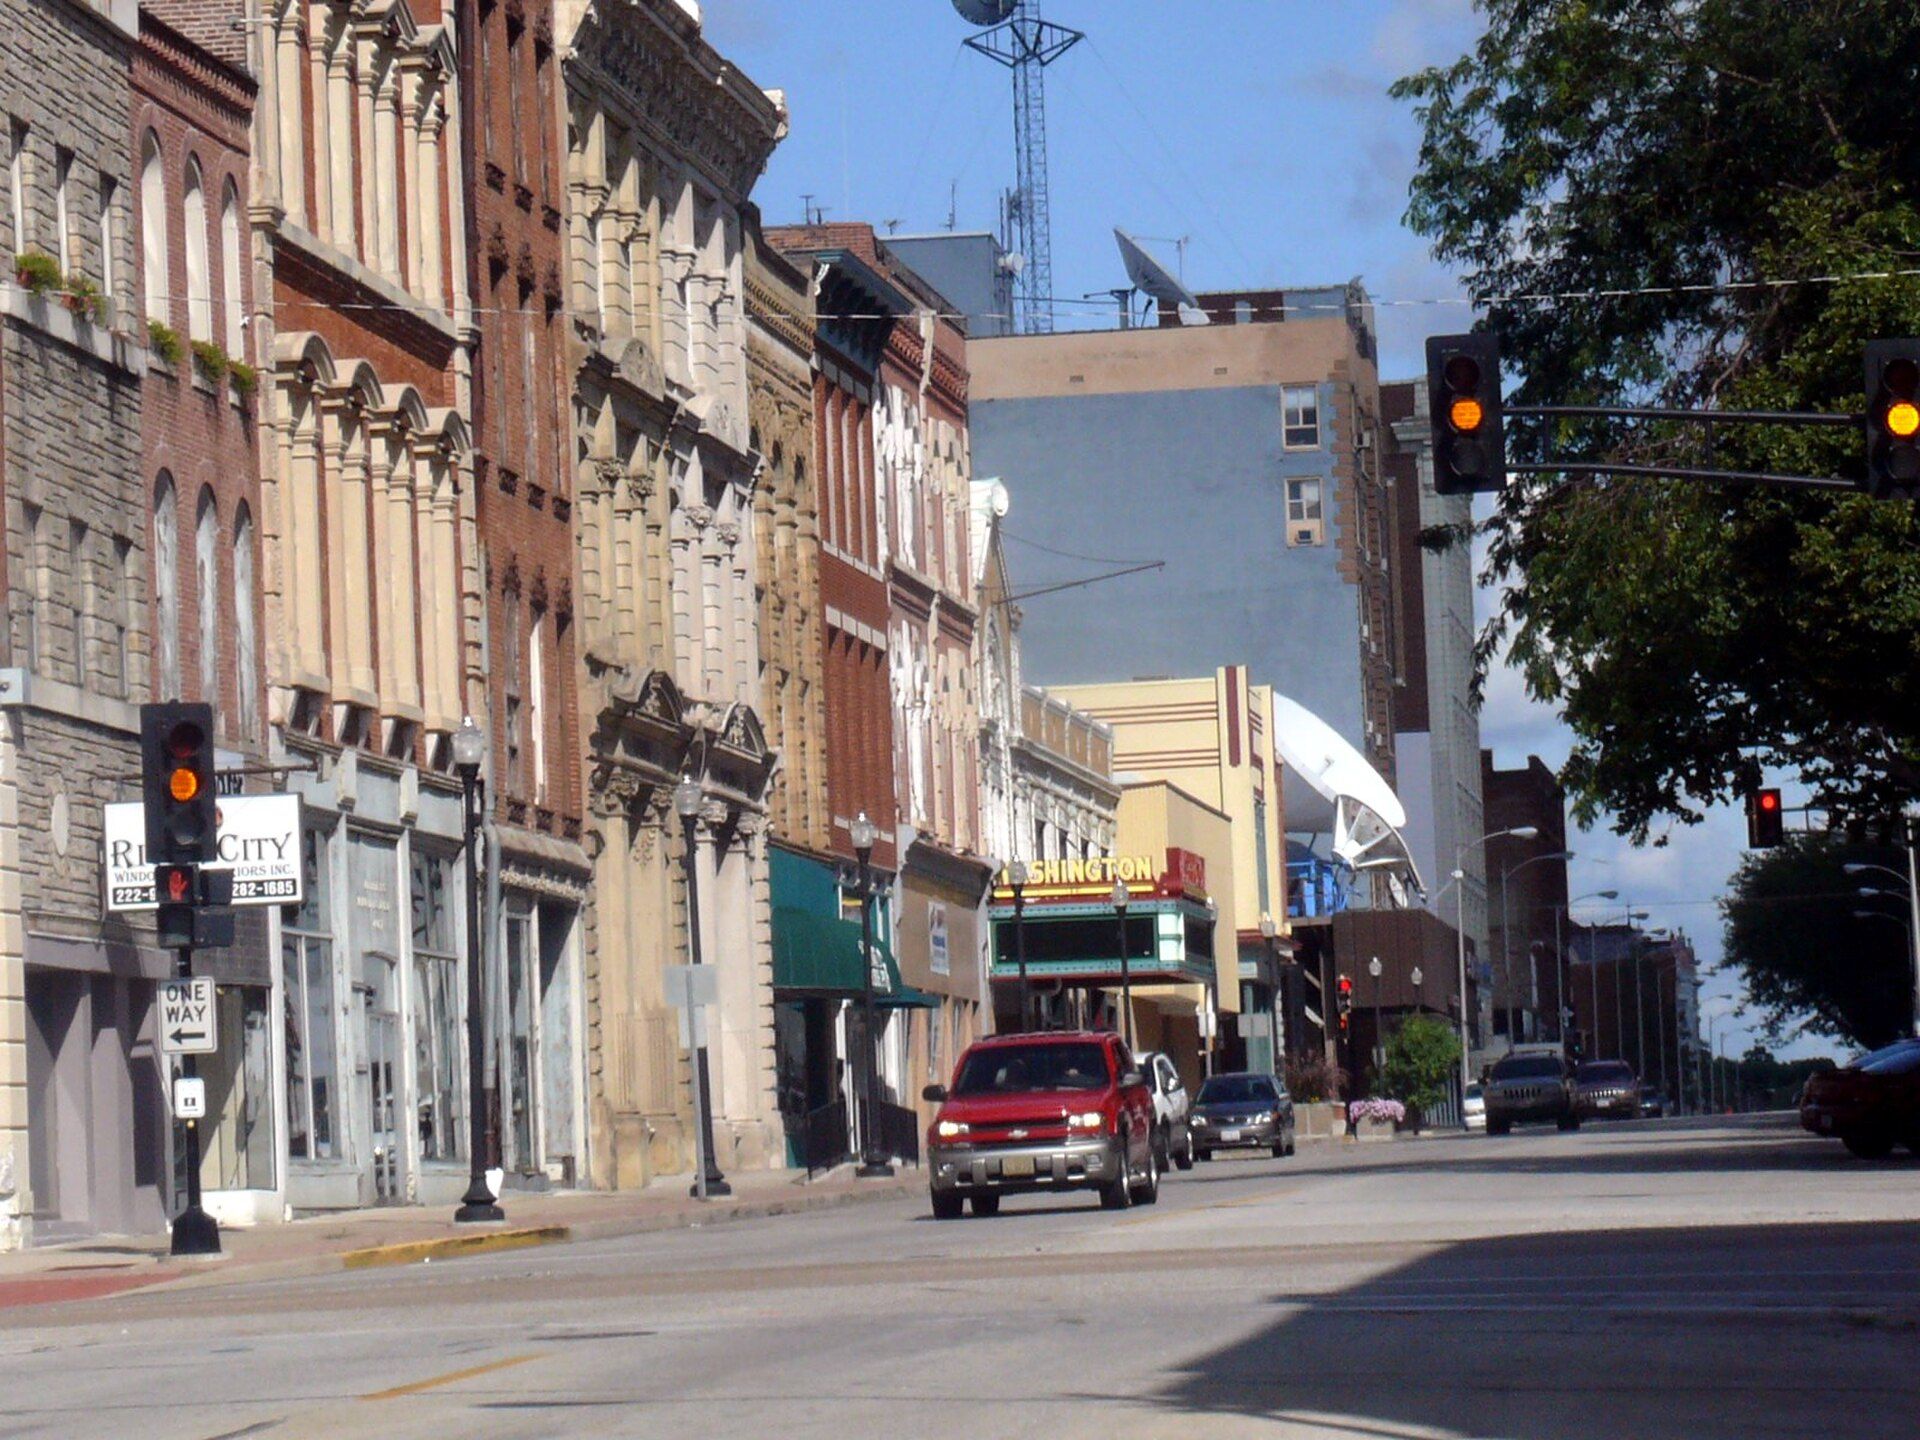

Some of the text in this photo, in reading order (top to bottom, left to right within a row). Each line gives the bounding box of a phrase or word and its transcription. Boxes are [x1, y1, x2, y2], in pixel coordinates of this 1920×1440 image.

[218, 831, 293, 862] CITY
[114, 871, 155, 883] WINDO
[1001, 856, 1152, 886] SHINGTON
[166, 984, 206, 1002] ONE
[166, 1005, 206, 1023] WAY
